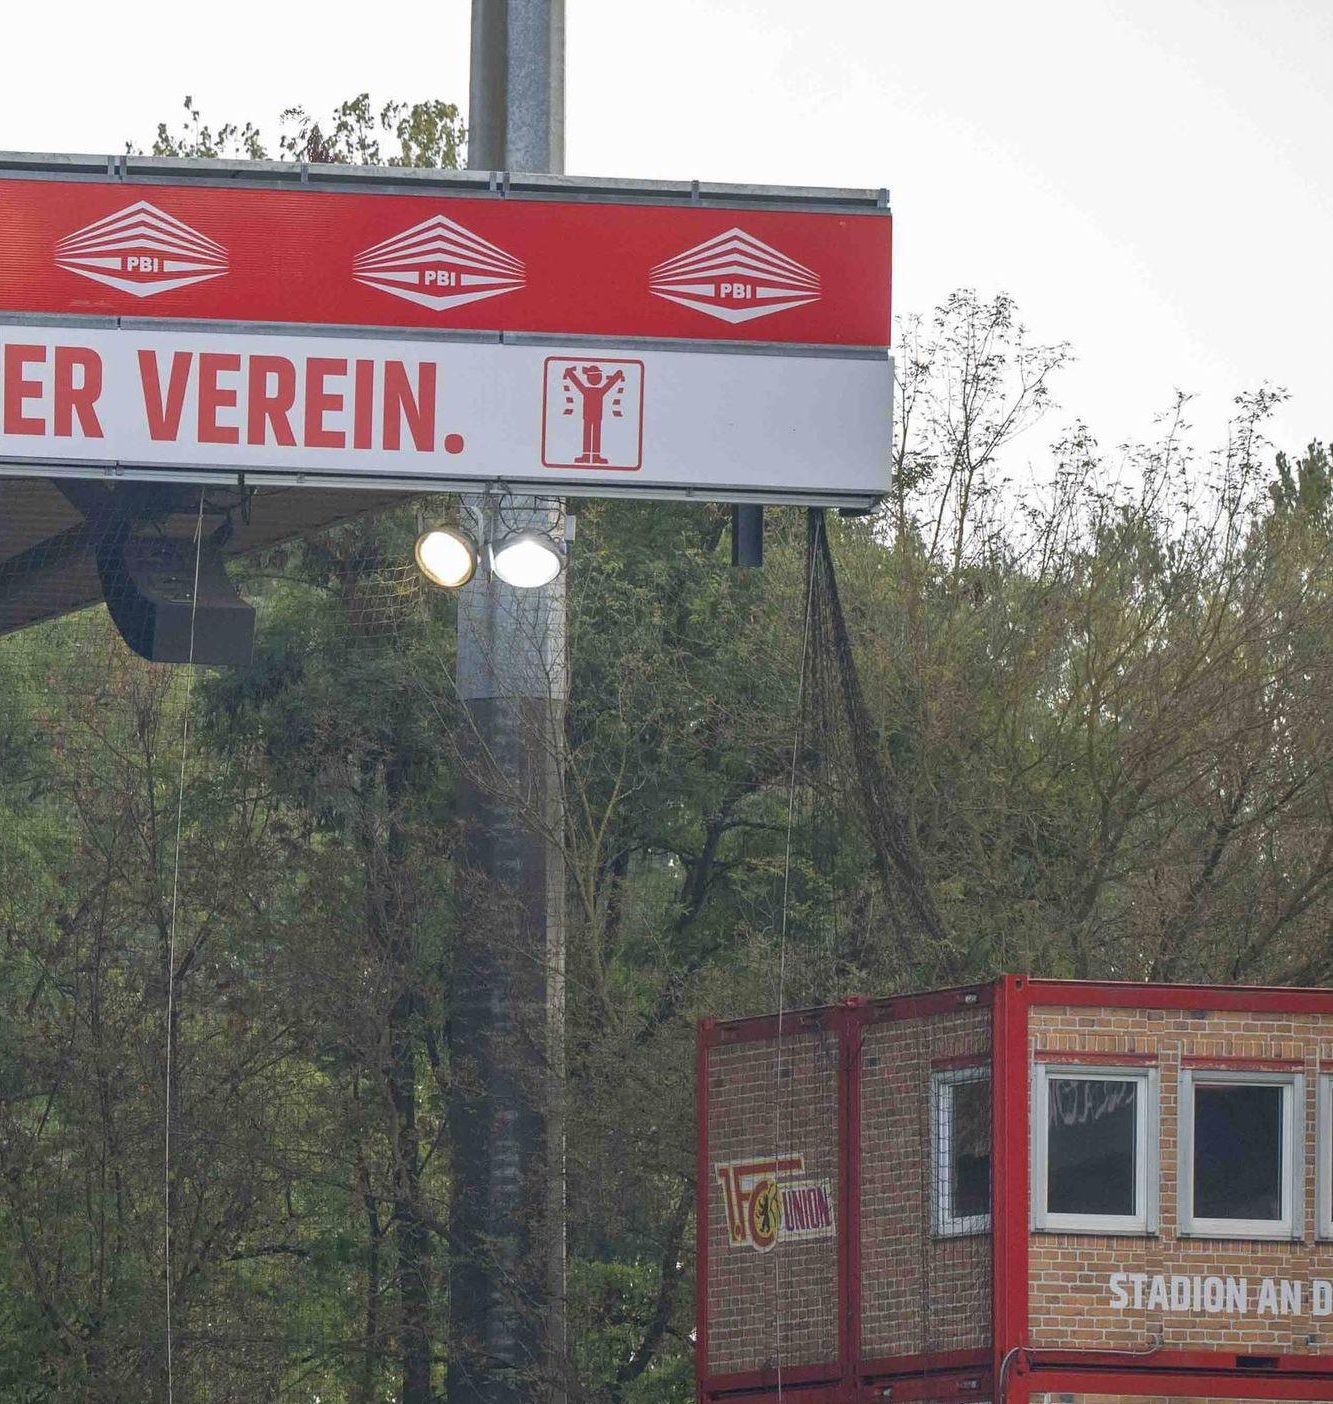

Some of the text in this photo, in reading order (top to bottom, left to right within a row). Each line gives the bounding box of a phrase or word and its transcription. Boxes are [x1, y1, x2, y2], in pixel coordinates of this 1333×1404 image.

[126, 256, 161, 274] PBI
[423, 270, 458, 288] PBI
[719, 282, 754, 300] PBI
[137, 348, 465, 455] VEREIN.
[782, 1186, 831, 1231] UNION
[1109, 1271, 1248, 1315] STADION
[1257, 1279, 1301, 1316] AN
